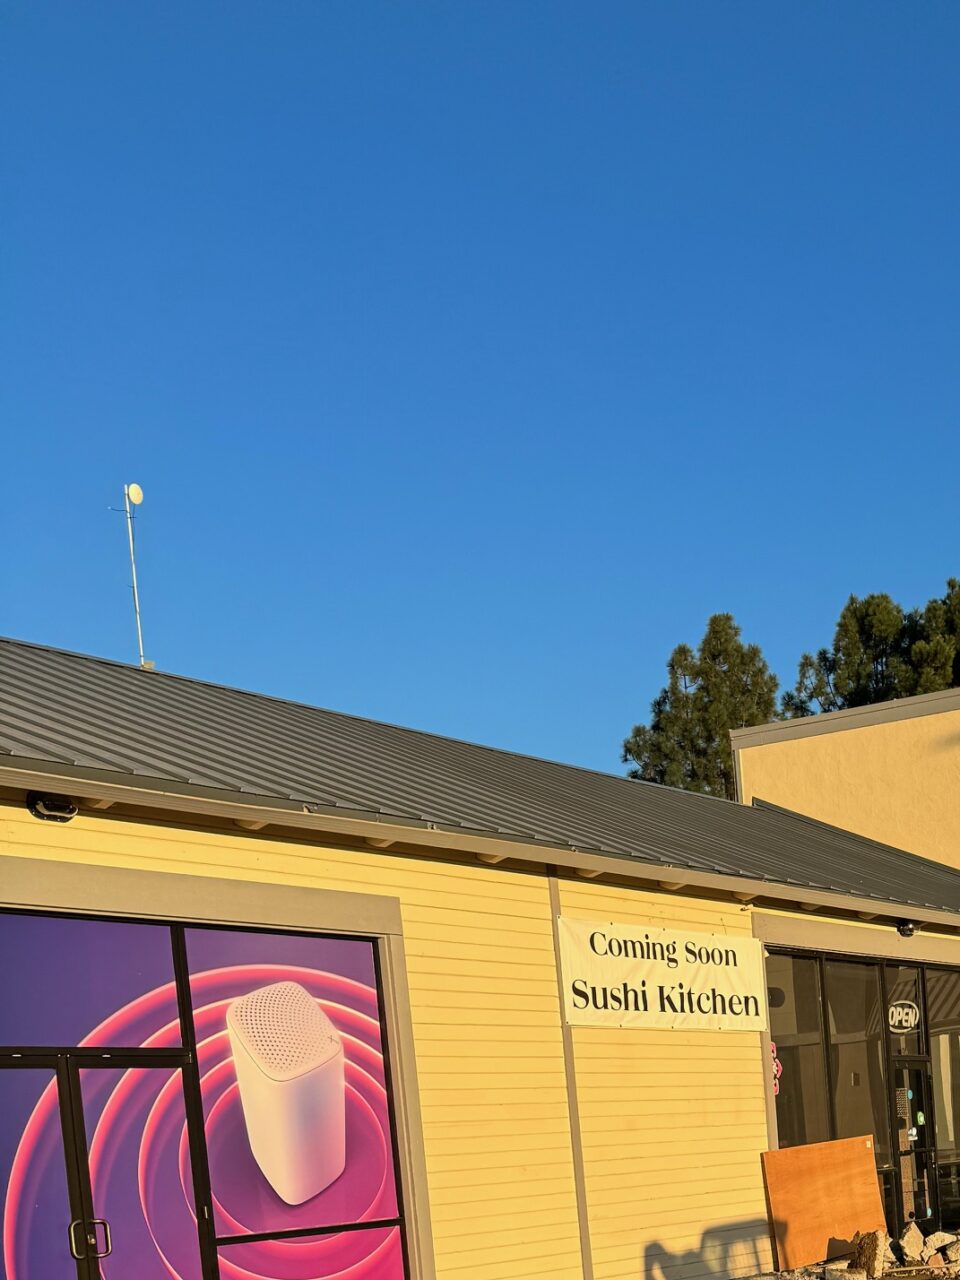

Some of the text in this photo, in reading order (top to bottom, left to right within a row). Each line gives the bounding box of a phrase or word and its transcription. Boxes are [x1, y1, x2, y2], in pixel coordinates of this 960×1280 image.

[589, 931, 738, 969] Coming Soon
[571, 979, 760, 1017] Sushi Kitchen
[888, 1006, 916, 1028] OPEN
